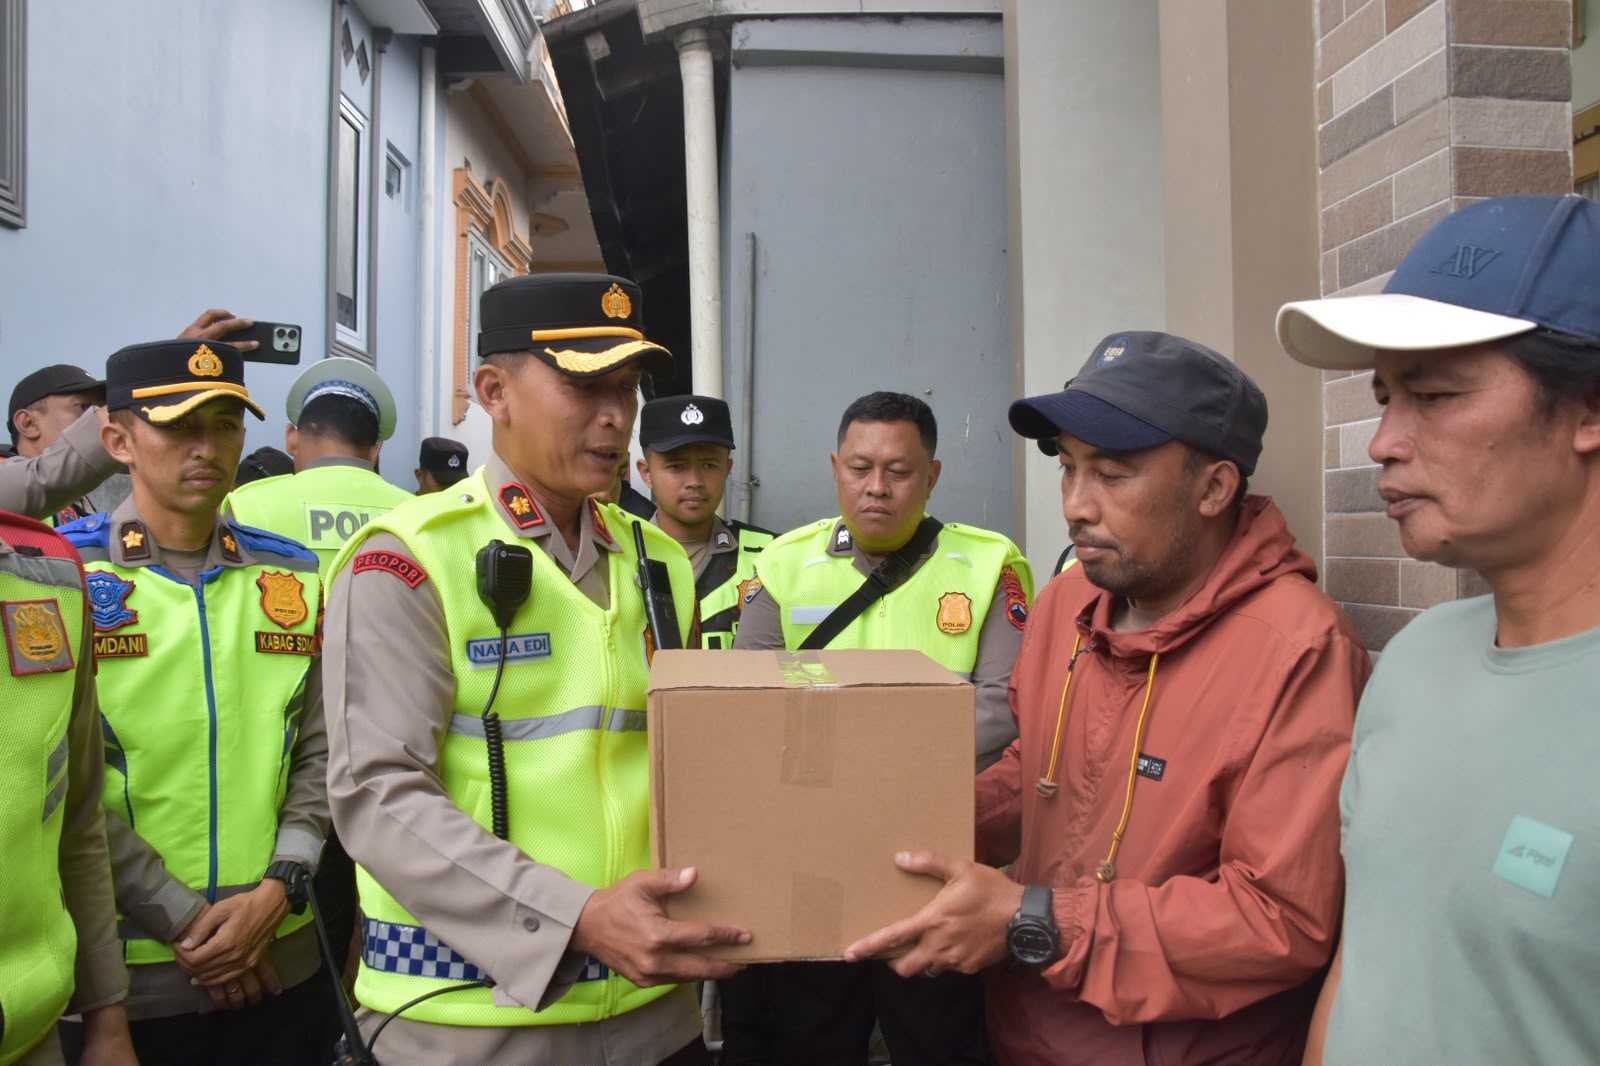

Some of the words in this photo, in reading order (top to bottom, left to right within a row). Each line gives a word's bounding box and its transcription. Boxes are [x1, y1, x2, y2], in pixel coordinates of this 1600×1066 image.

[357, 554, 419, 580] PELOPOR
[260, 634, 295, 650] KABAG
[296, 637, 314, 652] SDM
[524, 639, 547, 652] EDI
